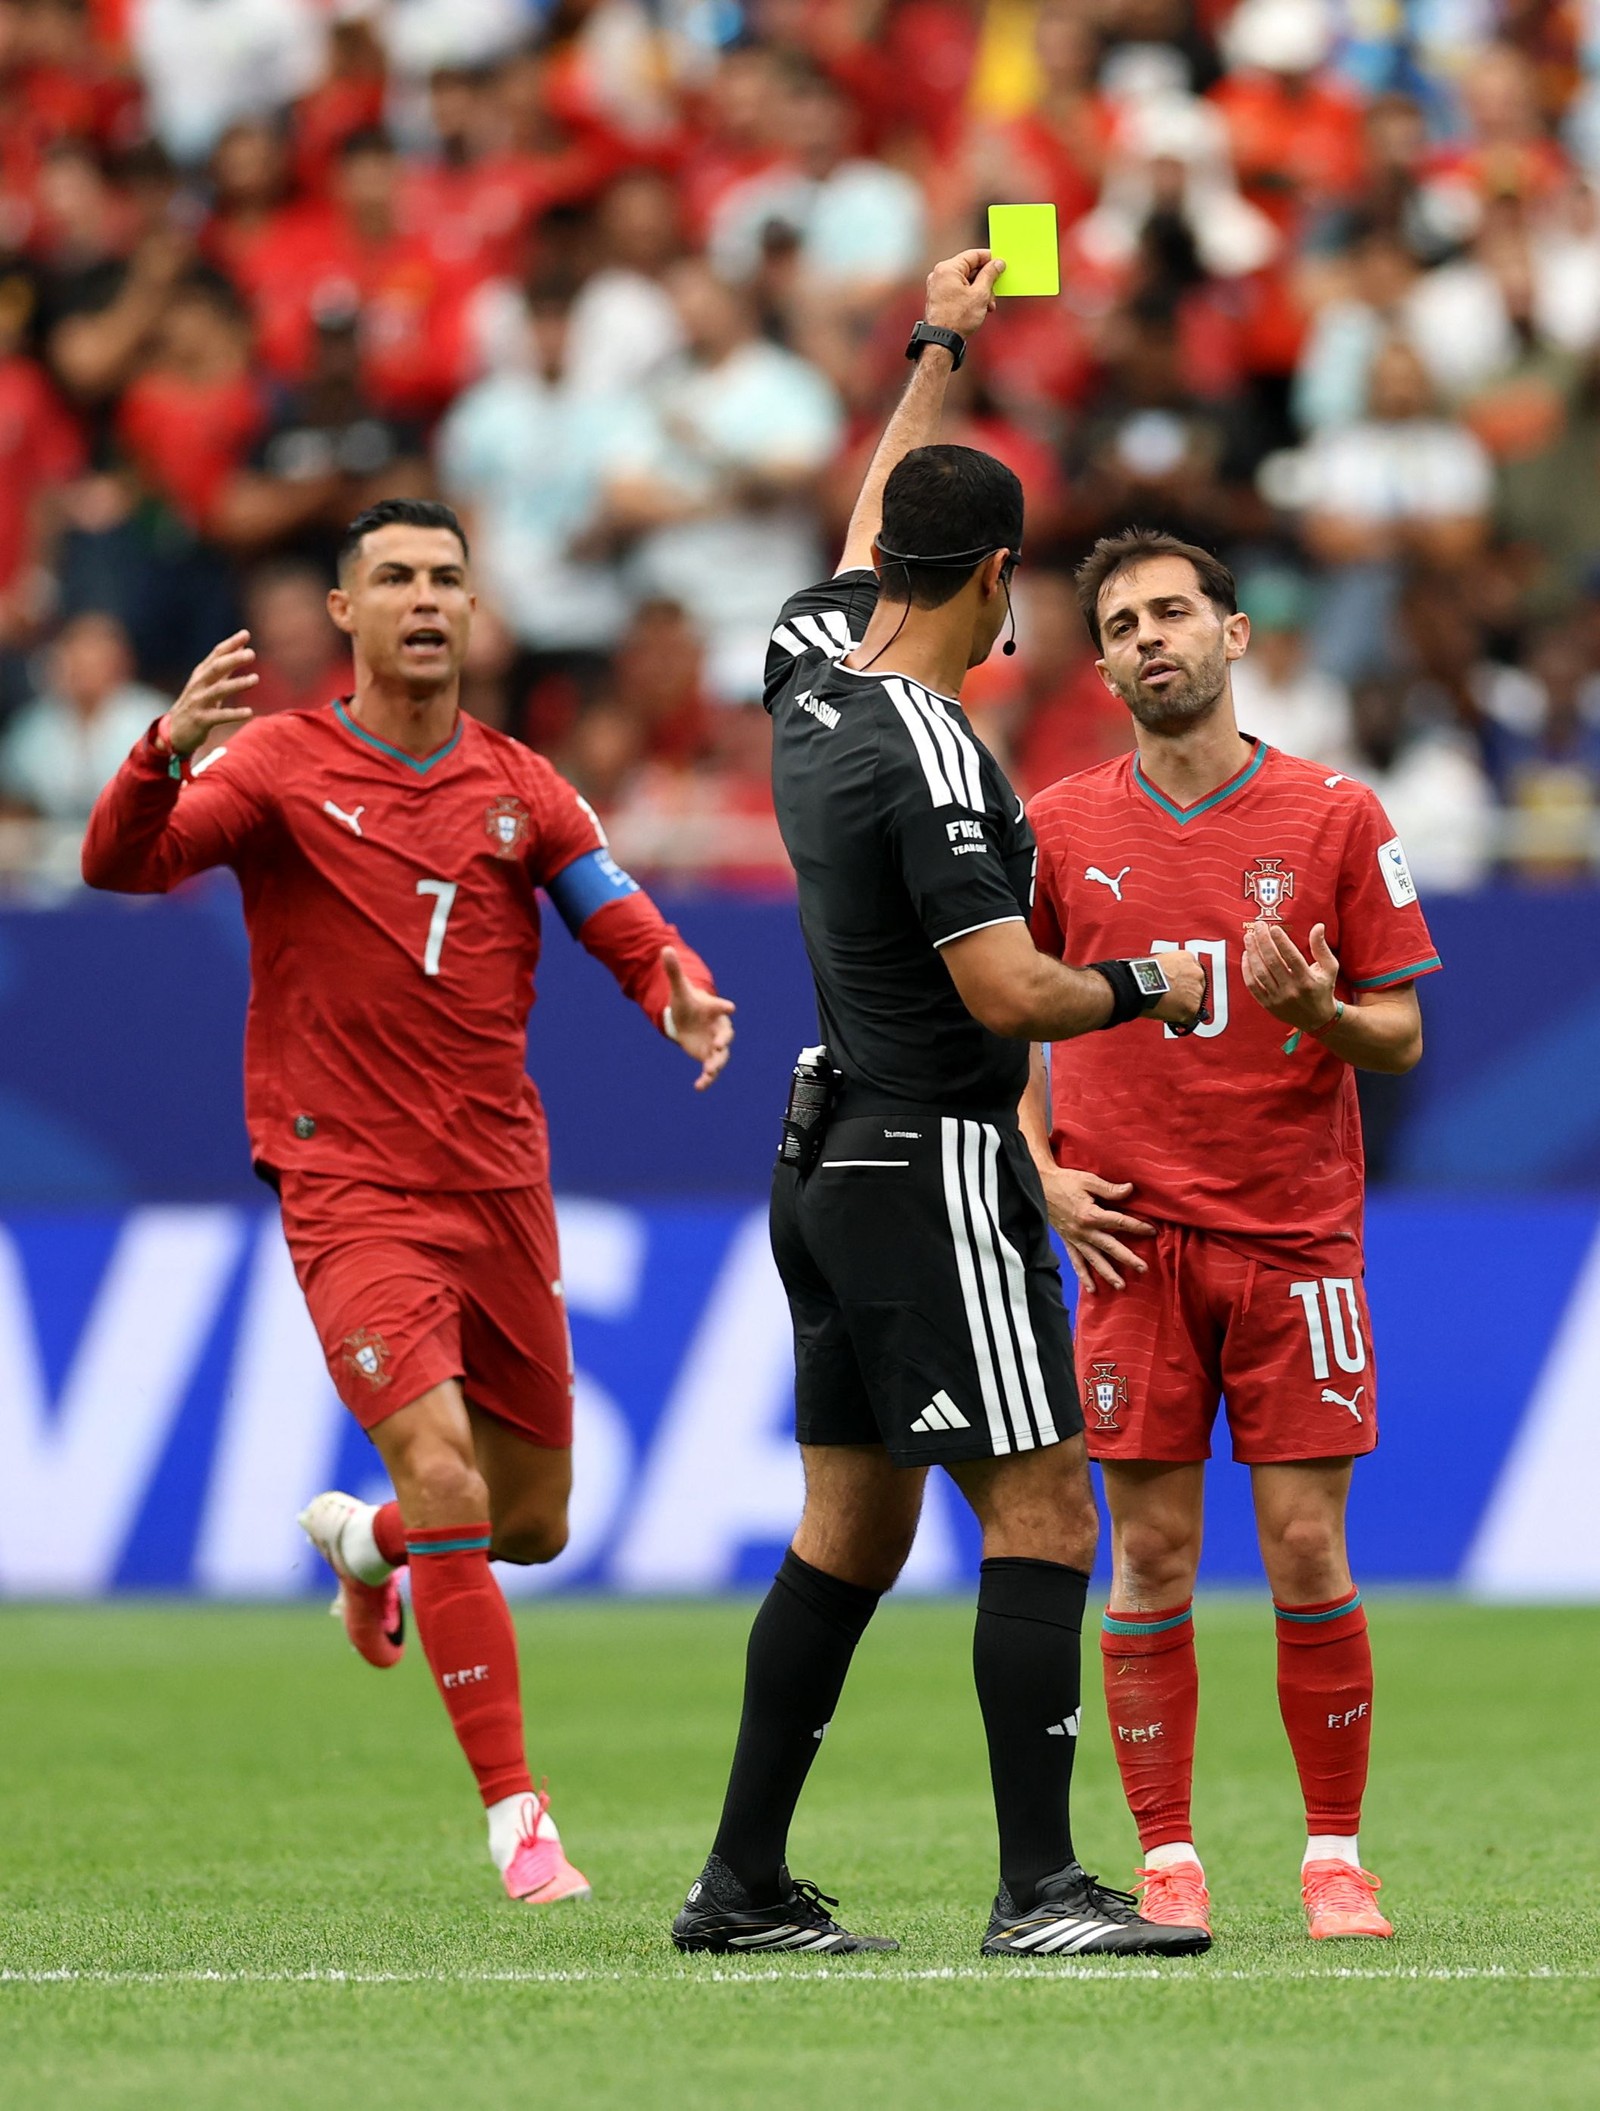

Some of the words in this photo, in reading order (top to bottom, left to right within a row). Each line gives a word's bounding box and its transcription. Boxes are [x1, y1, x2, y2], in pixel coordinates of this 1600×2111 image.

[946, 820, 984, 841] FIFA
[416, 878, 458, 976] 7
[1289, 1277, 1366, 1380] 10
